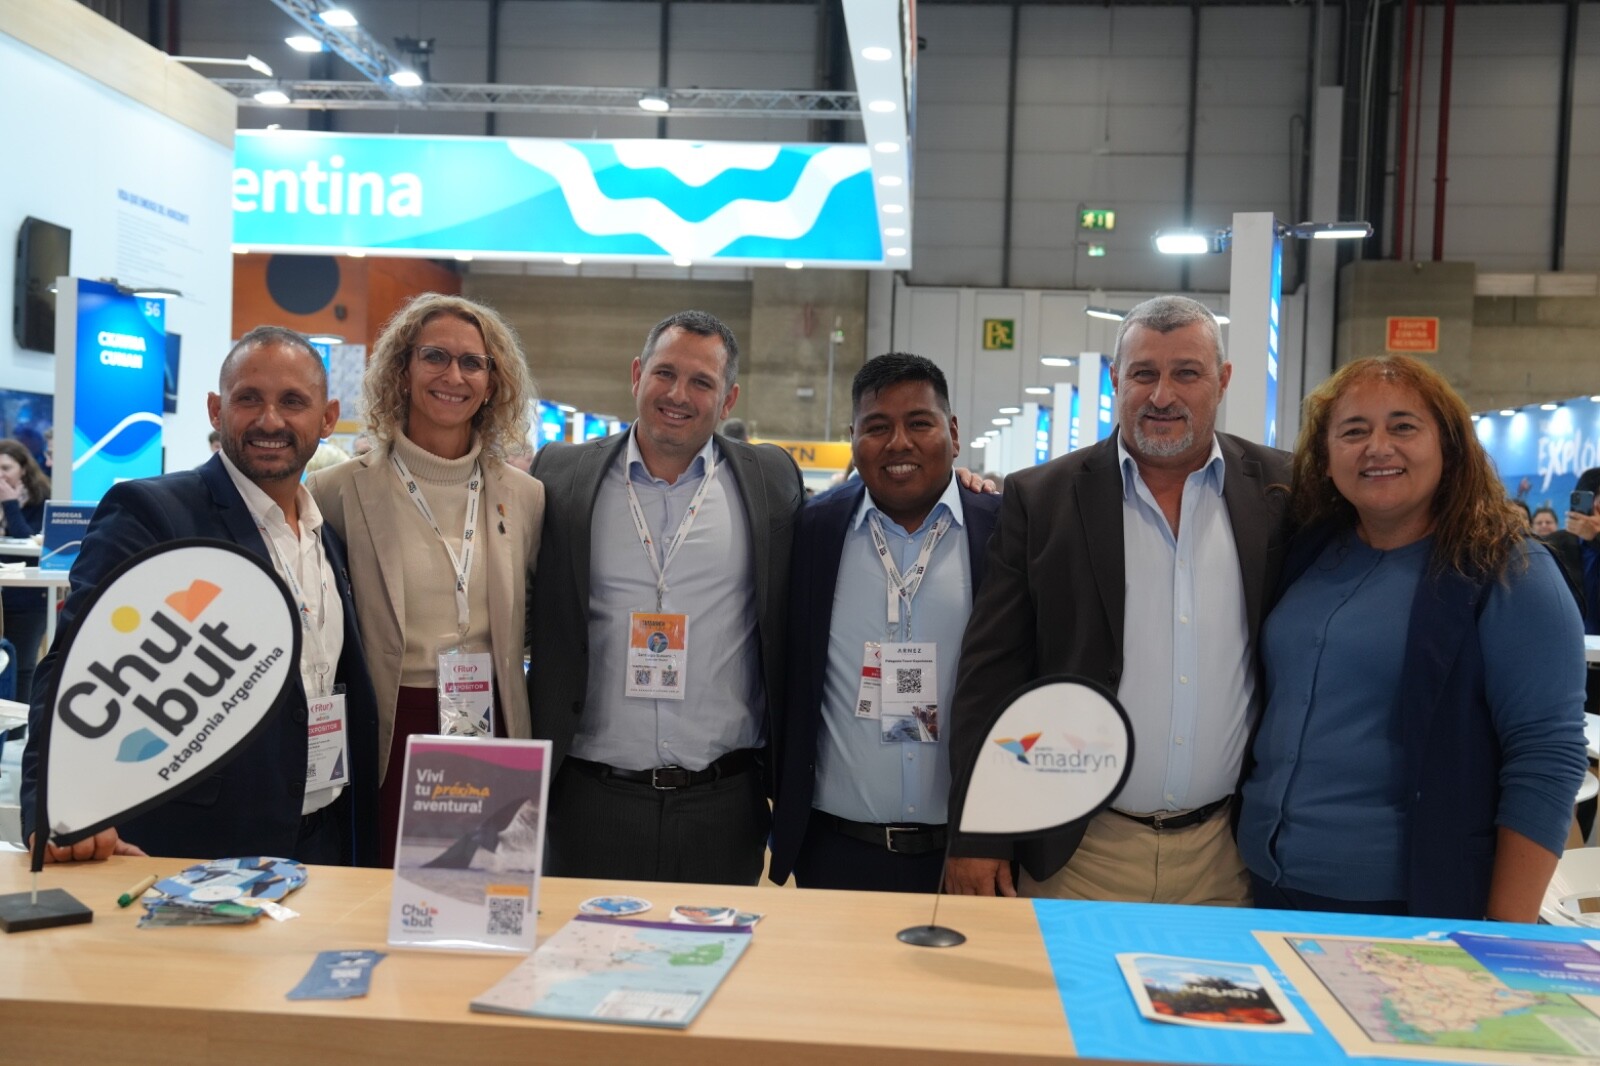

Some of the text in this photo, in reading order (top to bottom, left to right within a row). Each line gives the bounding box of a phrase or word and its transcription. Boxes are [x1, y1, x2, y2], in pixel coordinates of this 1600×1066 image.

[232, 155, 422, 217] entina
[144, 302, 161, 317] 56
[52, 511, 82, 519] BODEGAS
[58, 610, 193, 739] Chu
[132, 621, 258, 737] but
[157, 646, 284, 781] Patagonia Argentina
[1034, 750, 1118, 772] madryn
[415, 783, 431, 796] tu
[413, 800, 484, 814] aventura!
